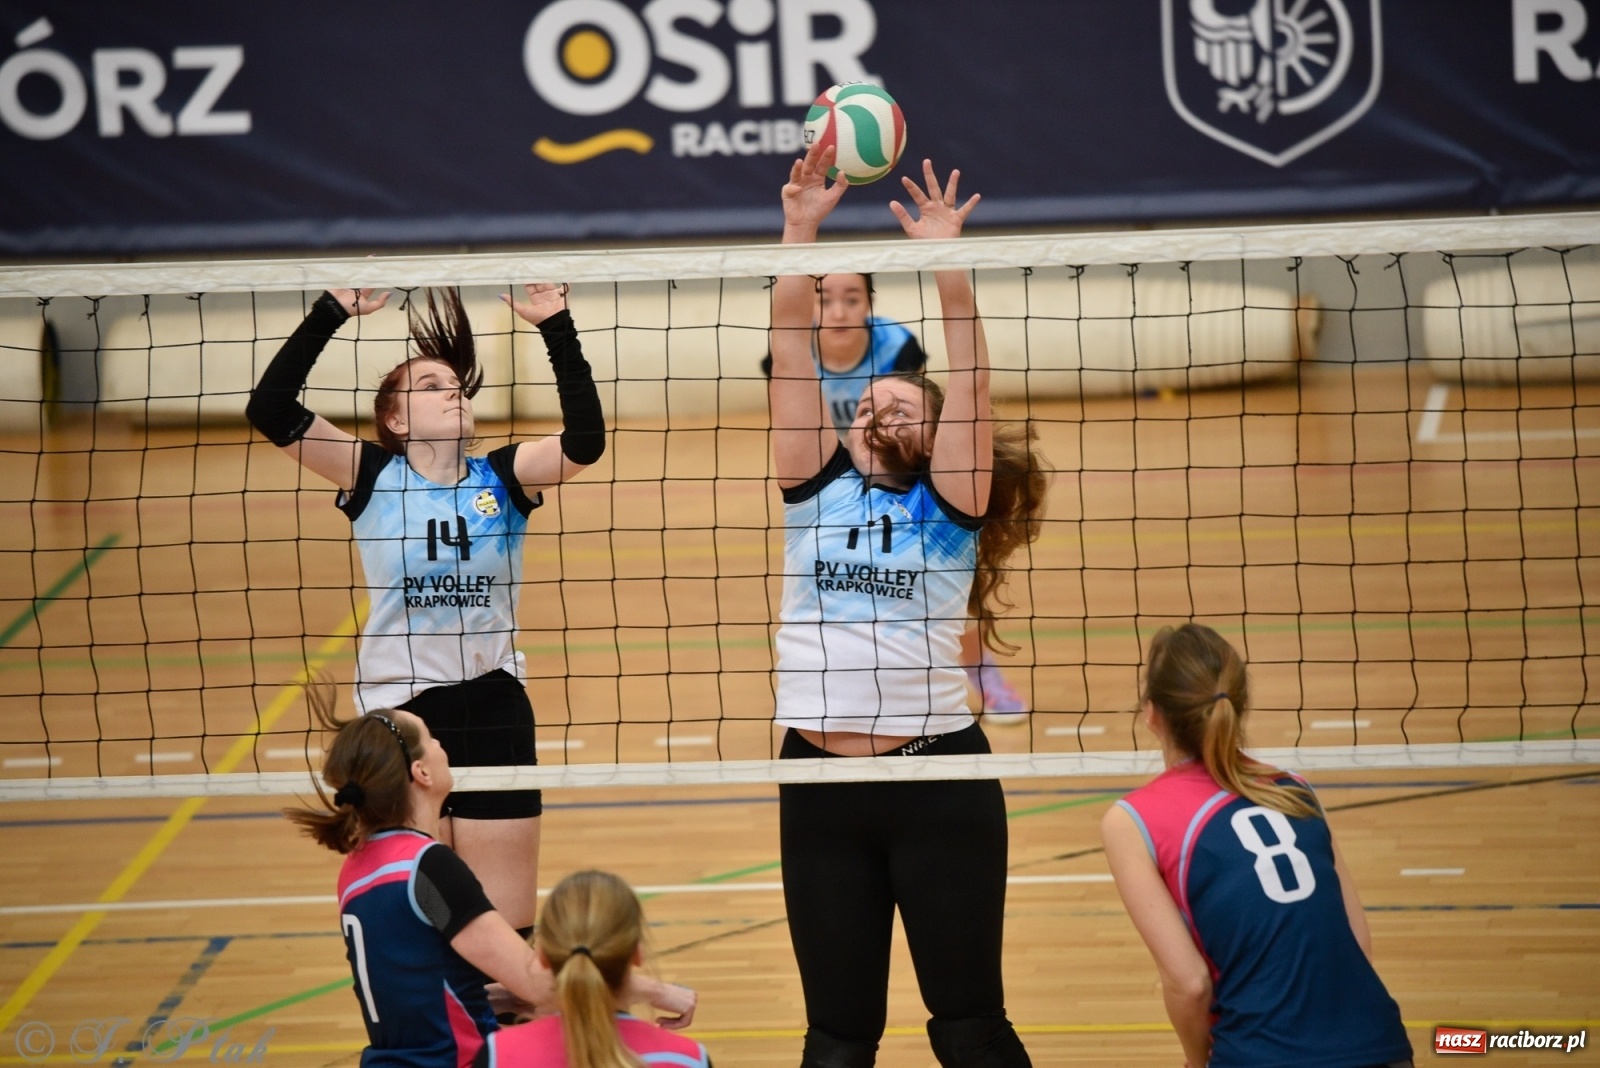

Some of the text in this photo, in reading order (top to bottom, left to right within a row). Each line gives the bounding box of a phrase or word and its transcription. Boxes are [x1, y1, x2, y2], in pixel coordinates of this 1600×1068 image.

[671, 119, 806, 157] RACIB
[427, 515, 473, 561] 14
[404, 575, 496, 593] PV VOLLEY
[815, 560, 918, 586] PV VOLLEY
[816, 578, 914, 600] KRAPKOWICE
[405, 595, 491, 608] KRAPKOWICE
[1230, 806, 1316, 904] 8
[342, 913, 379, 1023] 7
